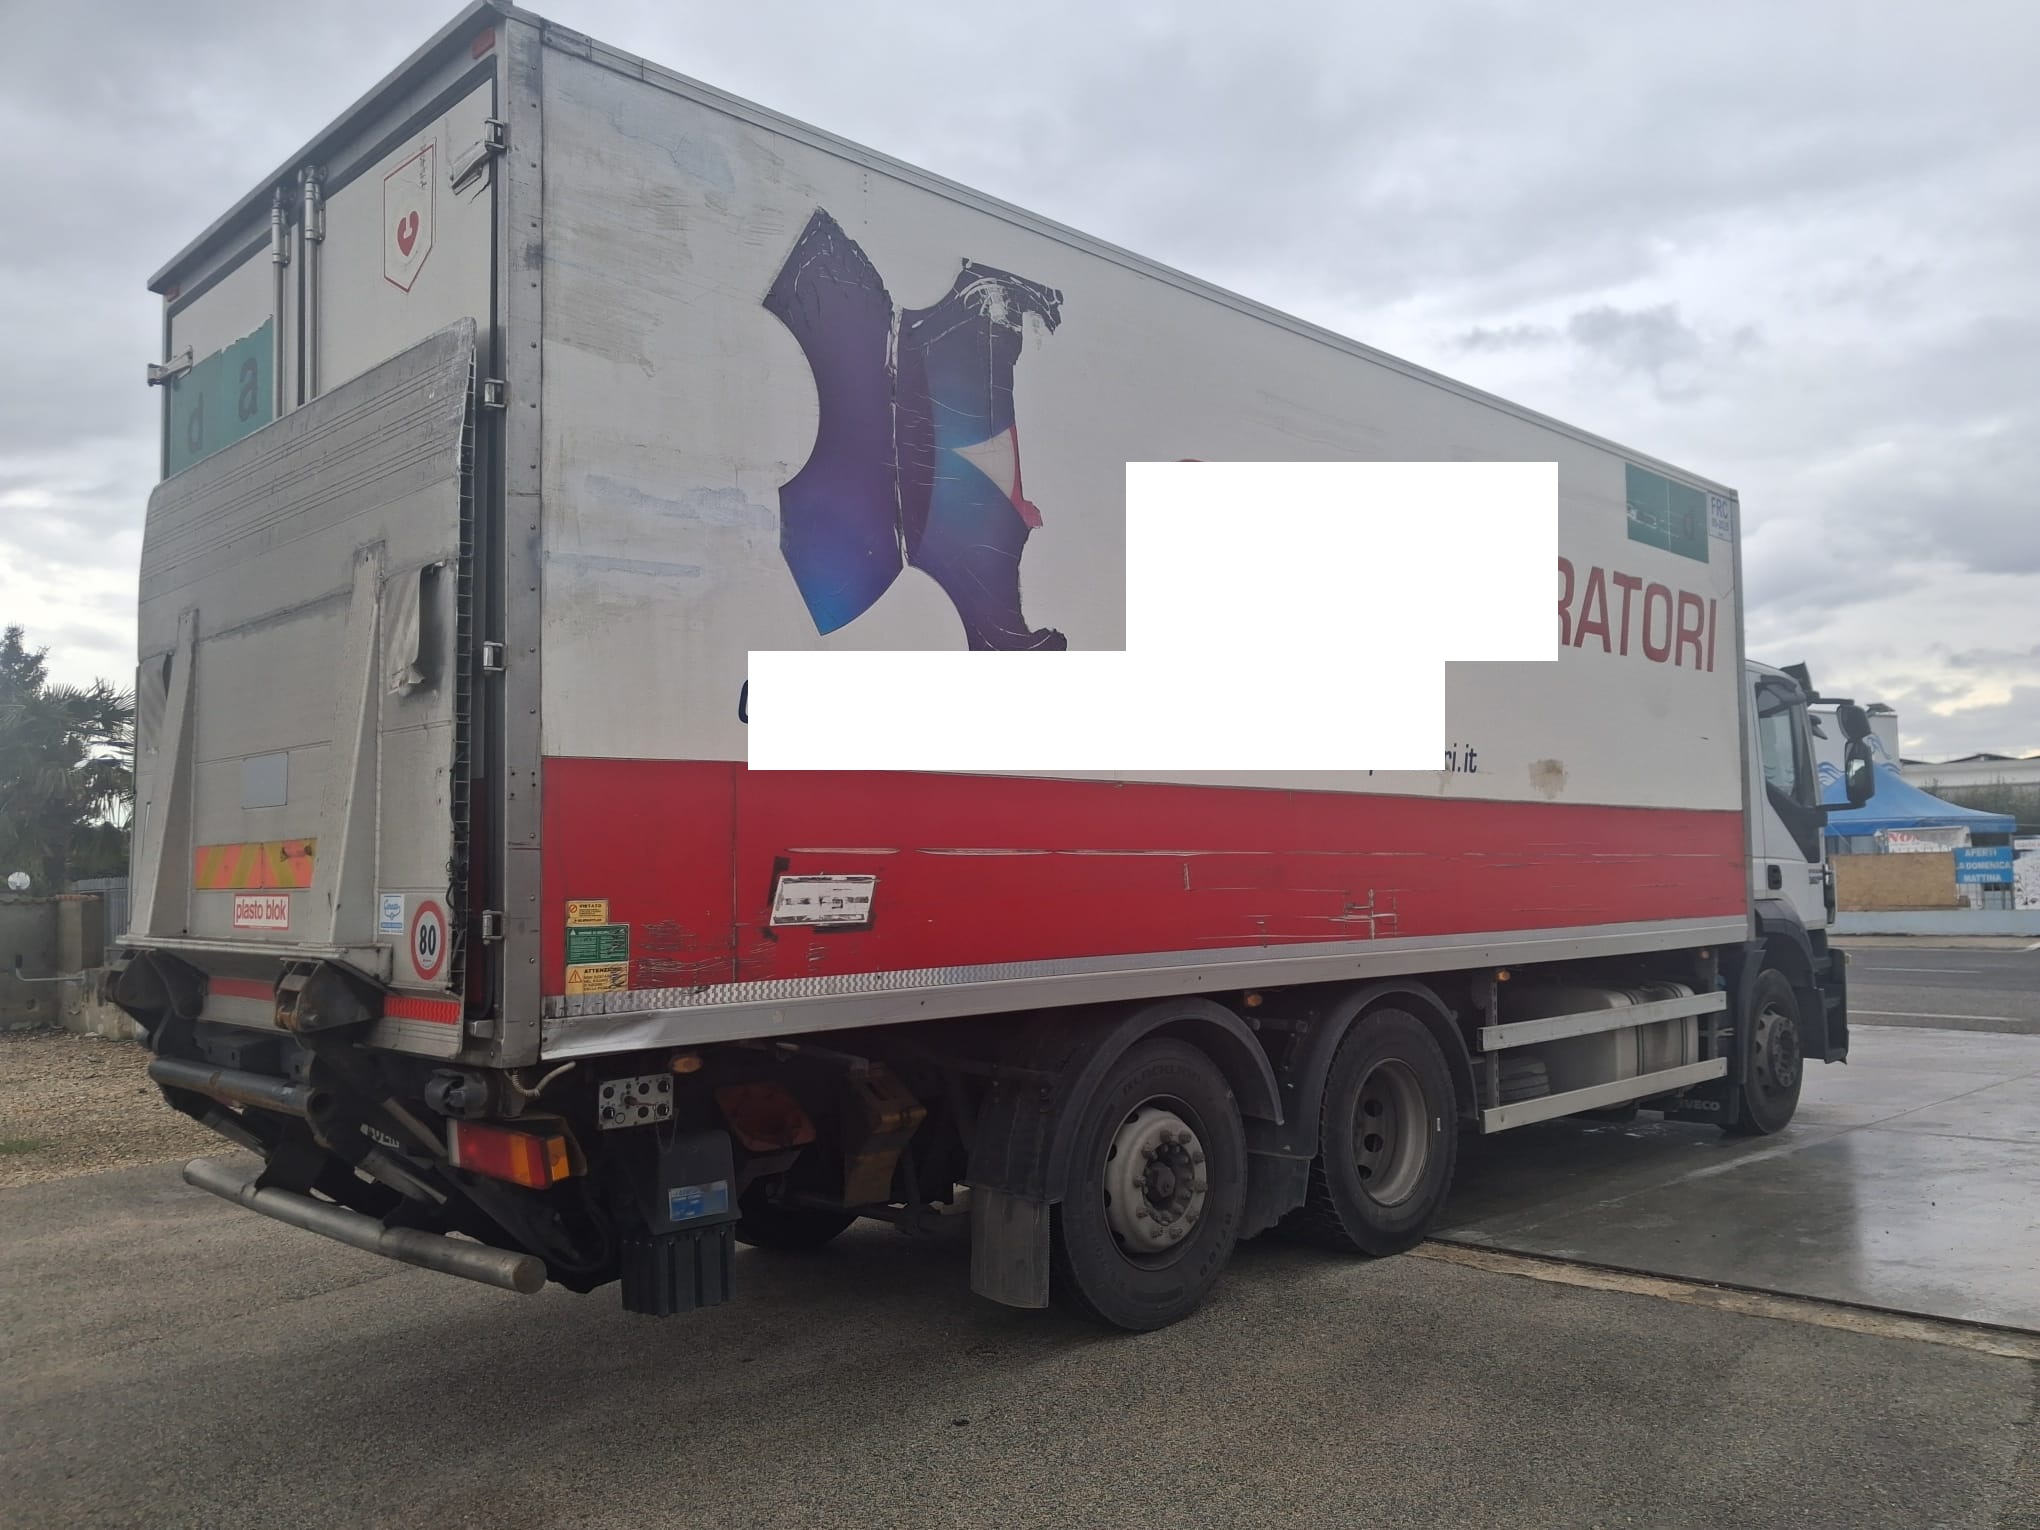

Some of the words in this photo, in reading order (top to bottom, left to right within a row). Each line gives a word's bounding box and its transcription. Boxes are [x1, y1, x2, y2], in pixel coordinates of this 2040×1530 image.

[1710, 496, 1729, 520] FRC
[1964, 848, 1998, 857] APERTI
[1966, 861, 2012, 870] DOMENICA
[1963, 873, 2002, 883] MATTINA
[236, 898, 263, 924] plasto
[266, 898, 287, 921] blok
[419, 924, 437, 956] 80
